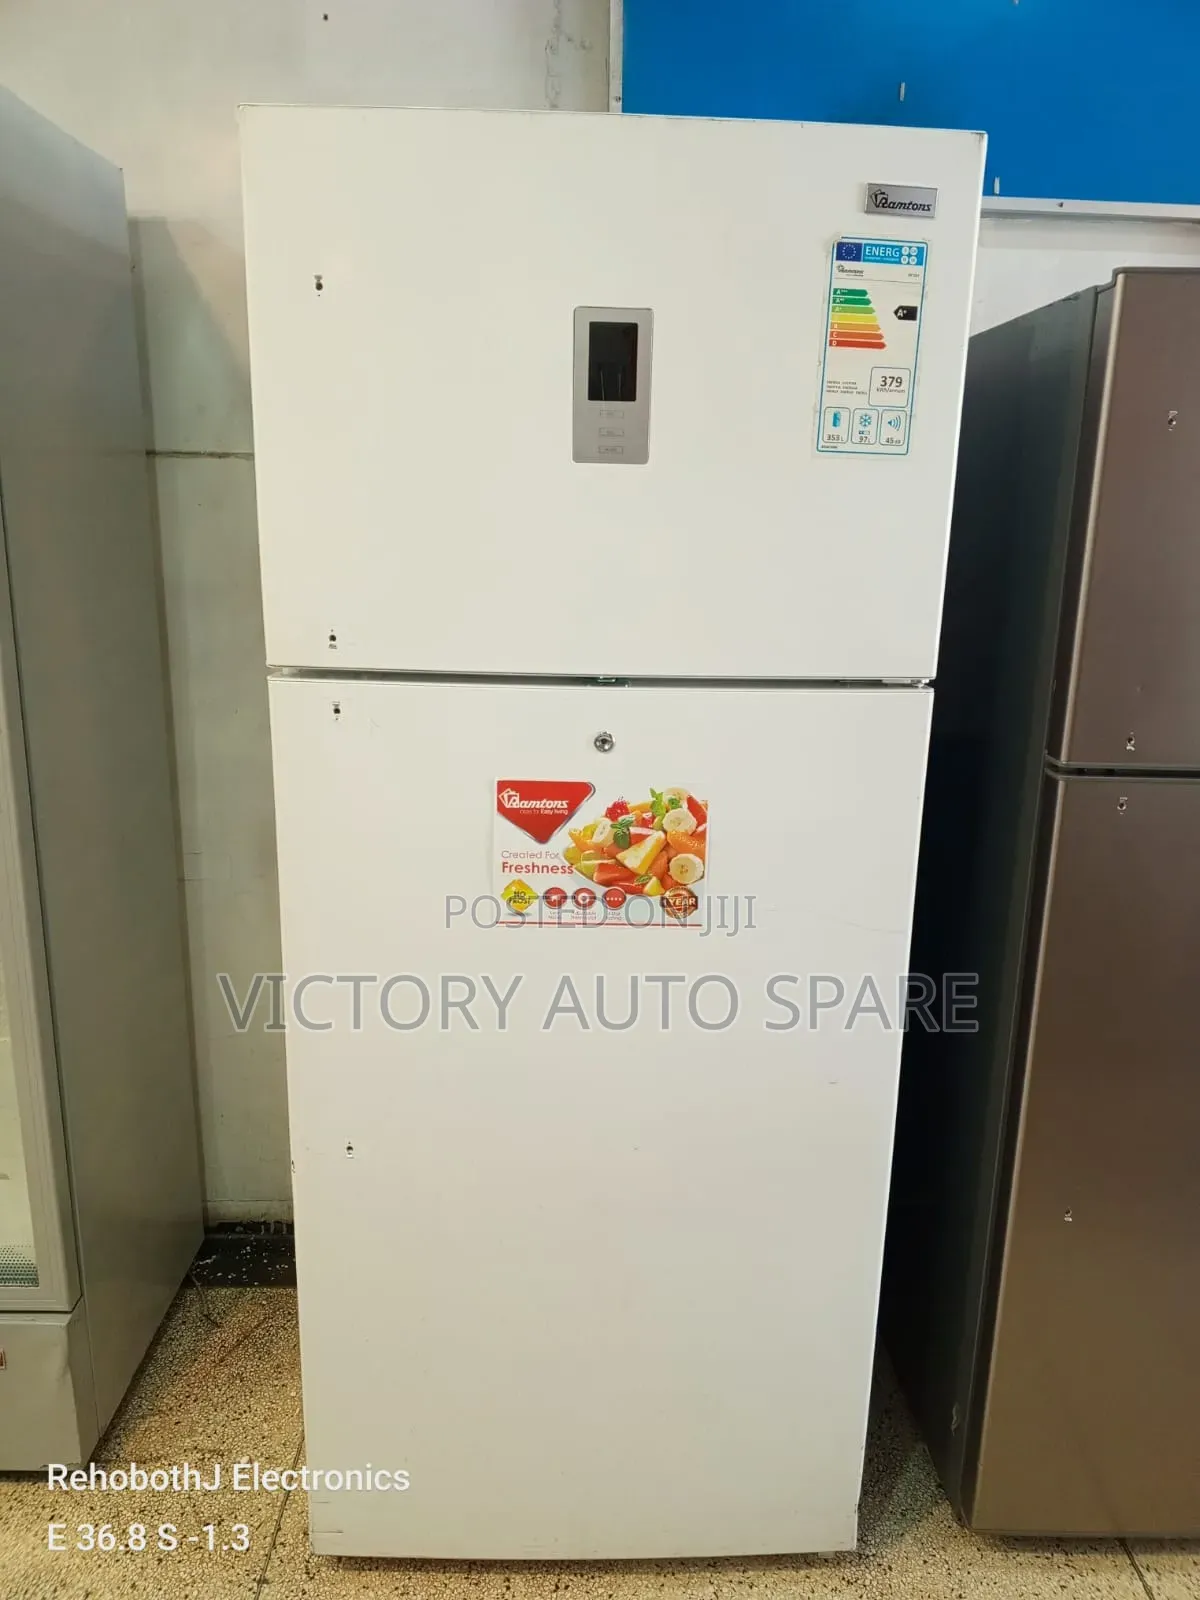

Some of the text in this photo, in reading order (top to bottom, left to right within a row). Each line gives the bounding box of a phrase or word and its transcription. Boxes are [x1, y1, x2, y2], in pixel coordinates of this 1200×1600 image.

[870, 189, 932, 212] Ramtons
[865, 246, 900, 257] ENERG
[880, 375, 903, 388] 379
[826, 433, 840, 442] 353
[858, 435, 868, 443] 97
[499, 788, 569, 809] Ramtons
[501, 850, 560, 859] Created For
[502, 861, 575, 874] Freshness
[669, 897, 697, 906] YEAR
